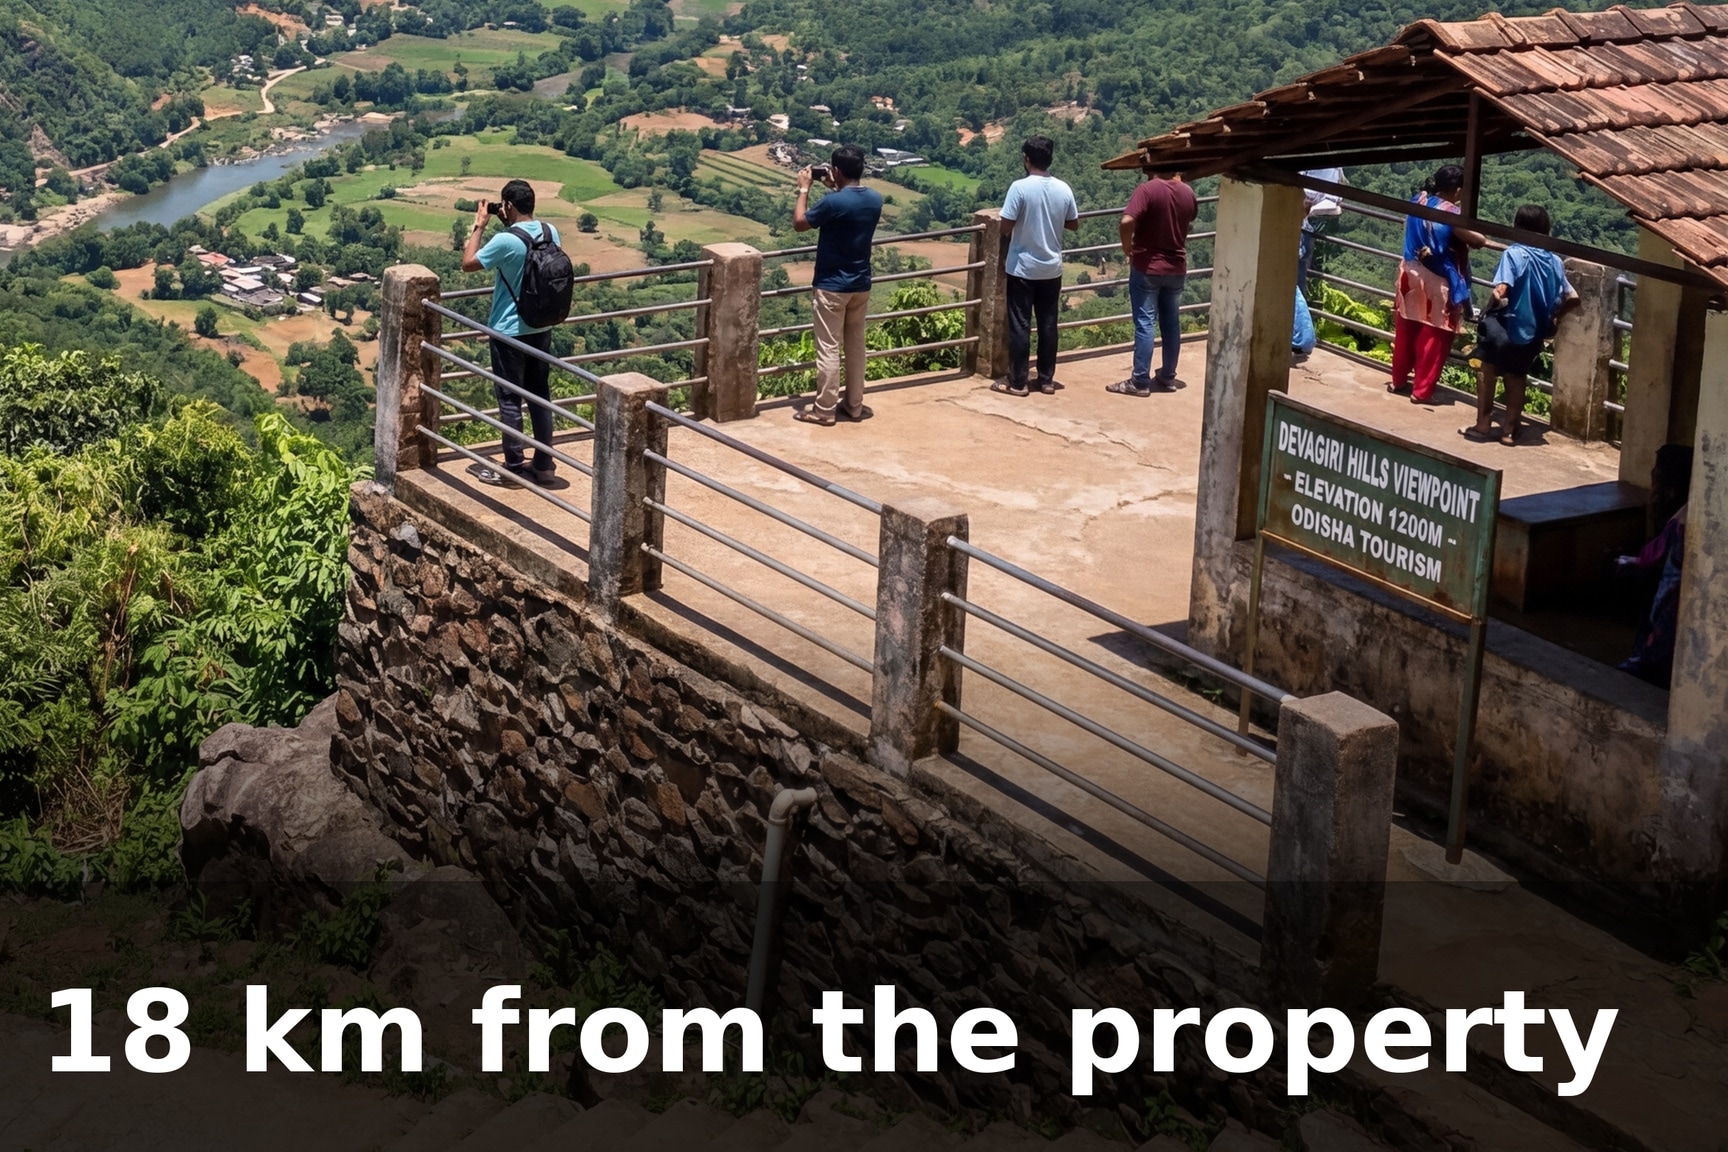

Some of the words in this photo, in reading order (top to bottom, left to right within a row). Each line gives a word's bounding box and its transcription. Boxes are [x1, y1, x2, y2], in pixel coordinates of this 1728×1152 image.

[1278, 421, 1345, 473] DEVAGIRI
[1347, 445, 1389, 490] HILLS
[1393, 462, 1480, 524] VIEWPOINT
[1294, 470, 1383, 525] ELEVATION
[1388, 507, 1443, 548] 1200M
[1291, 503, 1355, 548] ODISHA
[1360, 529, 1442, 583] TOURISM
